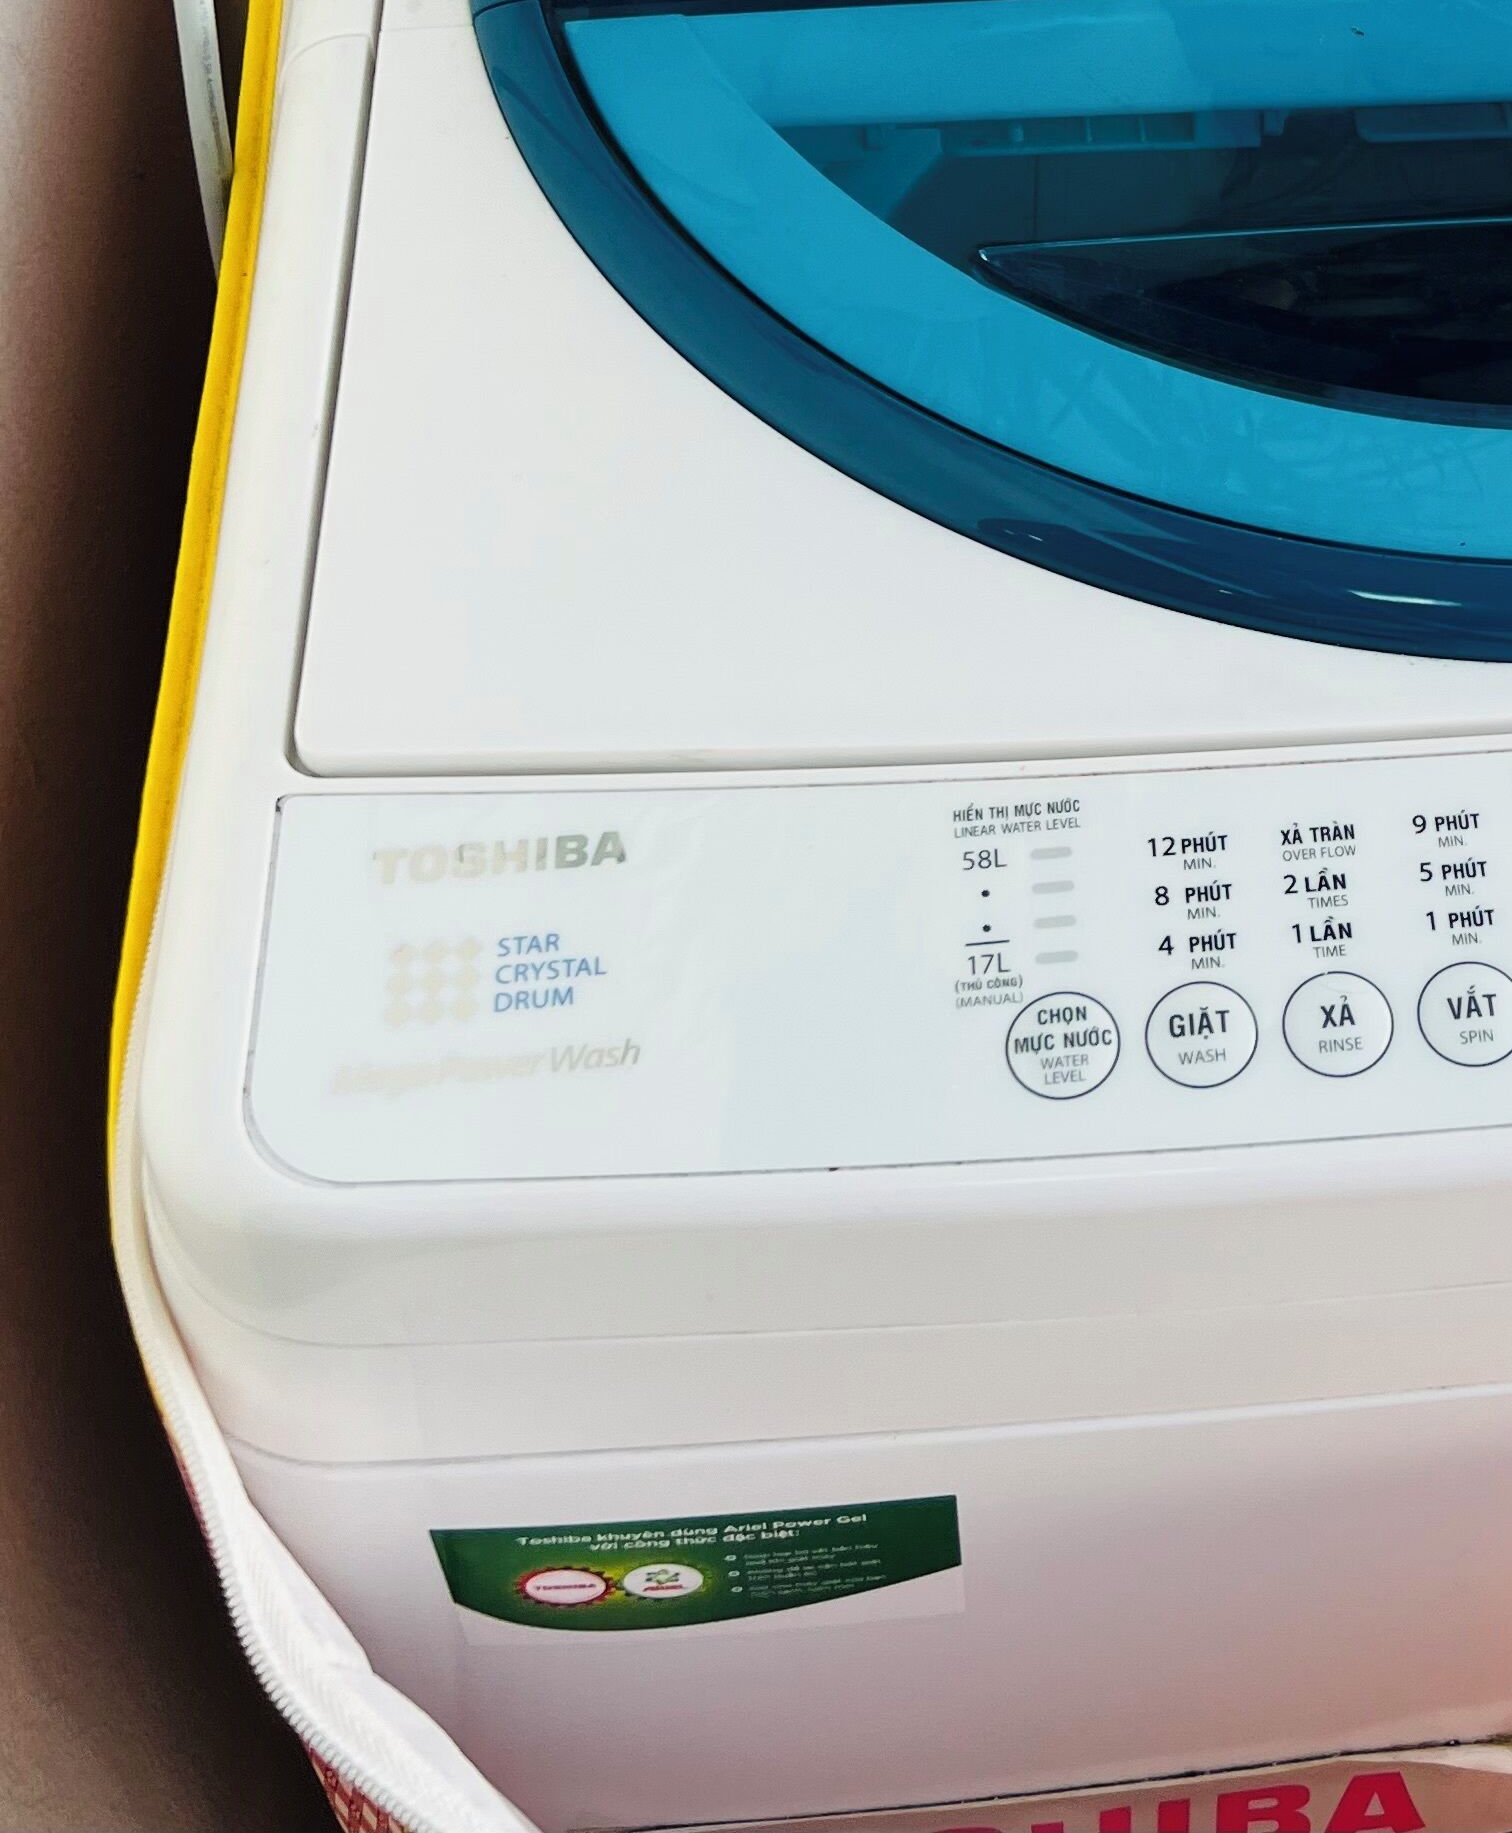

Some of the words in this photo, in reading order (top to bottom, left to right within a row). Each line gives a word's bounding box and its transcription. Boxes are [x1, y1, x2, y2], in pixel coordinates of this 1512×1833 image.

[954, 824, 996, 838] LINEAR
[1001, 820, 1041, 834] WATER
[1046, 817, 1081, 830] LEVEL
[1412, 815, 1427, 834] 9
[1435, 810, 1480, 831] PHÚT
[1147, 837, 1177, 857] 12
[1181, 833, 1228, 854] PHÚT
[1438, 836, 1467, 848] MIN.
[962, 849, 1008, 870] 58L
[1183, 858, 1217, 870] MIN.
[1282, 849, 1316, 862] OVER
[1321, 845, 1356, 858] FLOW
[1283, 875, 1298, 894] 2
[1304, 867, 1347, 892] LẦN
[1420, 863, 1433, 882] 5
[1441, 858, 1487, 879] PHÚT
[1154, 886, 1169, 906] 8
[1185, 881, 1232, 903] PHÚT
[1445, 884, 1474, 897] MIN.
[1307, 895, 1348, 909] TIMES
[1187, 907, 1221, 920] MIN.
[1426, 912, 1436, 930] 1
[1448, 906, 1494, 928] PHÚT
[1292, 924, 1301, 943] 1
[1310, 916, 1352, 942] LẦN
[497, 933, 560, 957] STAR
[1158, 936, 1174, 956] 4
[1189, 931, 1237, 952] PHÚT
[1312, 945, 1347, 958] TIME
[494, 956, 607, 985] CRYSTAL
[968, 953, 1011, 975] 17L
[493, 986, 574, 1014] DRUM
[956, 992, 1024, 1009] (MANUAL)
[1447, 985, 1497, 1020] VẮT
[1169, 1007, 1230, 1039] GIẶT
[1321, 996, 1356, 1028] XẢ
[1318, 1037, 1363, 1053] RINSE
[1459, 1030, 1494, 1044] SPIN
[550, 1038, 641, 1074] Wash
[1041, 1054, 1089, 1069] WATER
[1178, 1049, 1227, 1065] WASH
[1044, 1070, 1086, 1085] LEVEL
